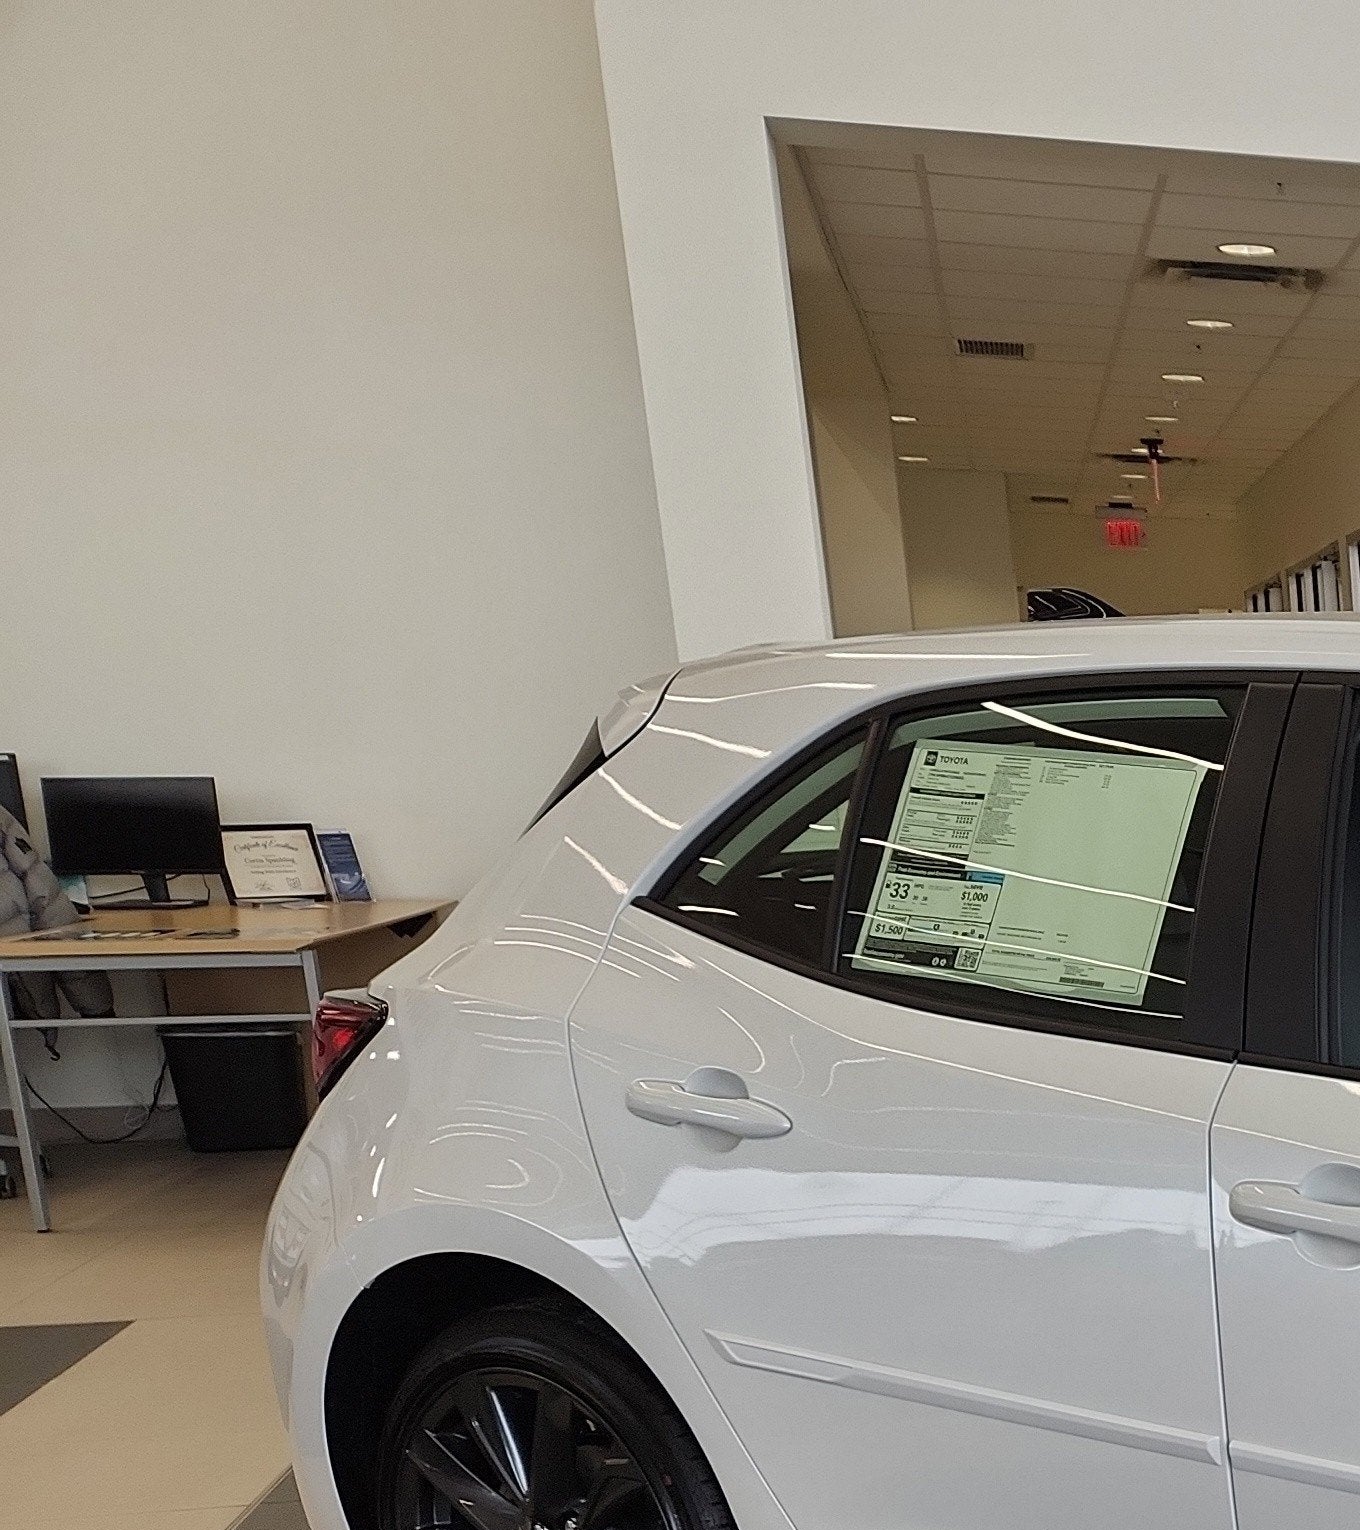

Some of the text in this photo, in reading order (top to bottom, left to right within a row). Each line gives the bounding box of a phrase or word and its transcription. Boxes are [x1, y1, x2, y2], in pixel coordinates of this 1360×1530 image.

[939, 755, 969, 766] TOYOTA
[889, 881, 911, 900] 33
[960, 891, 989, 903] $1,000
[874, 923, 903, 935] $1,500
